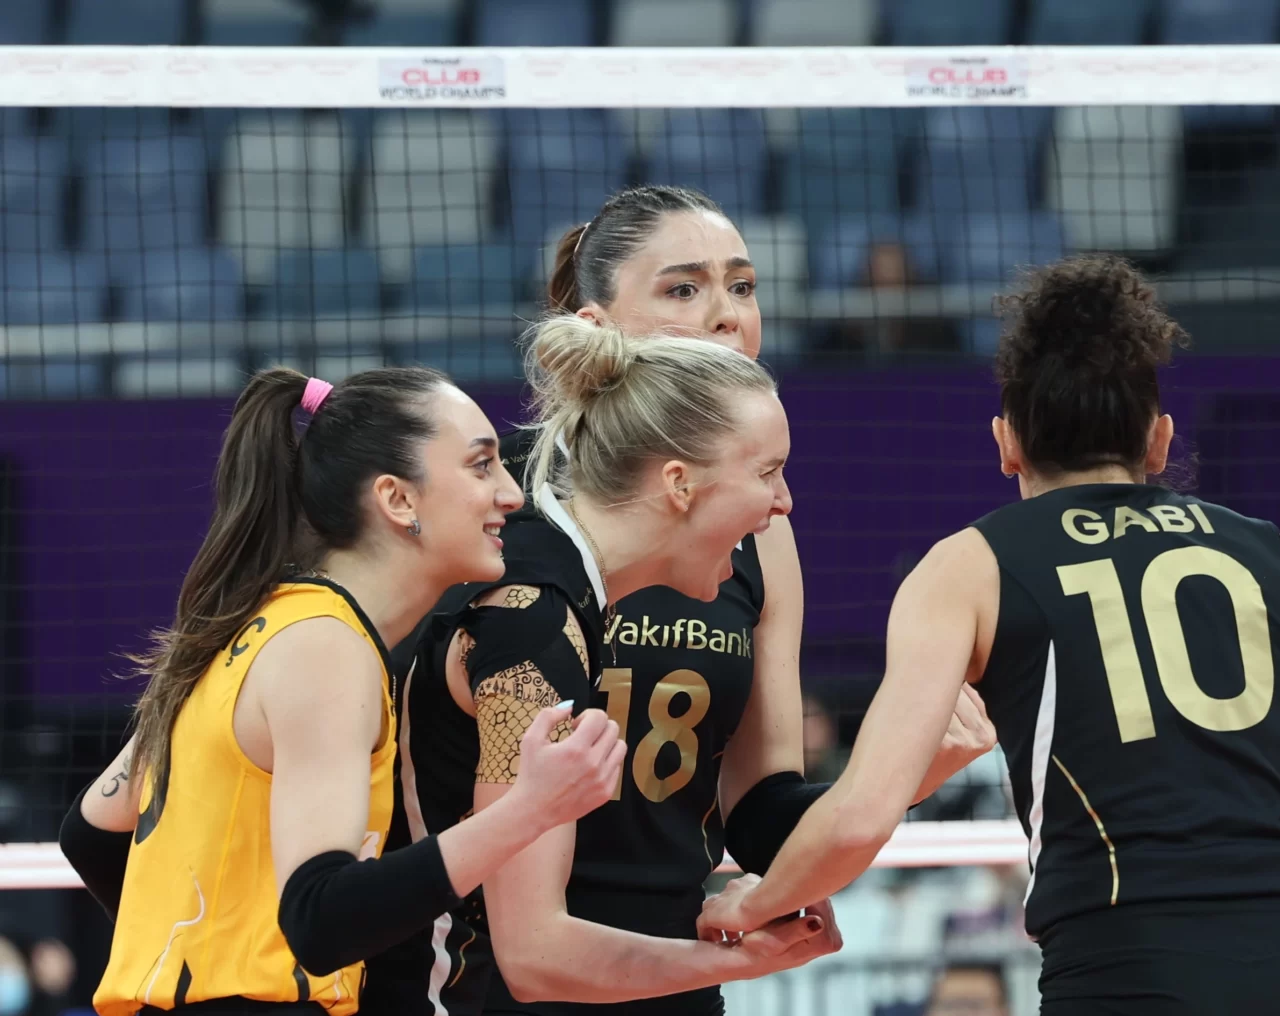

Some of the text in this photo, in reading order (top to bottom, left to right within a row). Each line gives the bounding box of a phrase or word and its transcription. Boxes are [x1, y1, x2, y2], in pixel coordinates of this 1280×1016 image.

[1061, 503, 1215, 545] GABI
[1056, 545, 1275, 744] 10
[598, 668, 711, 803] 18
